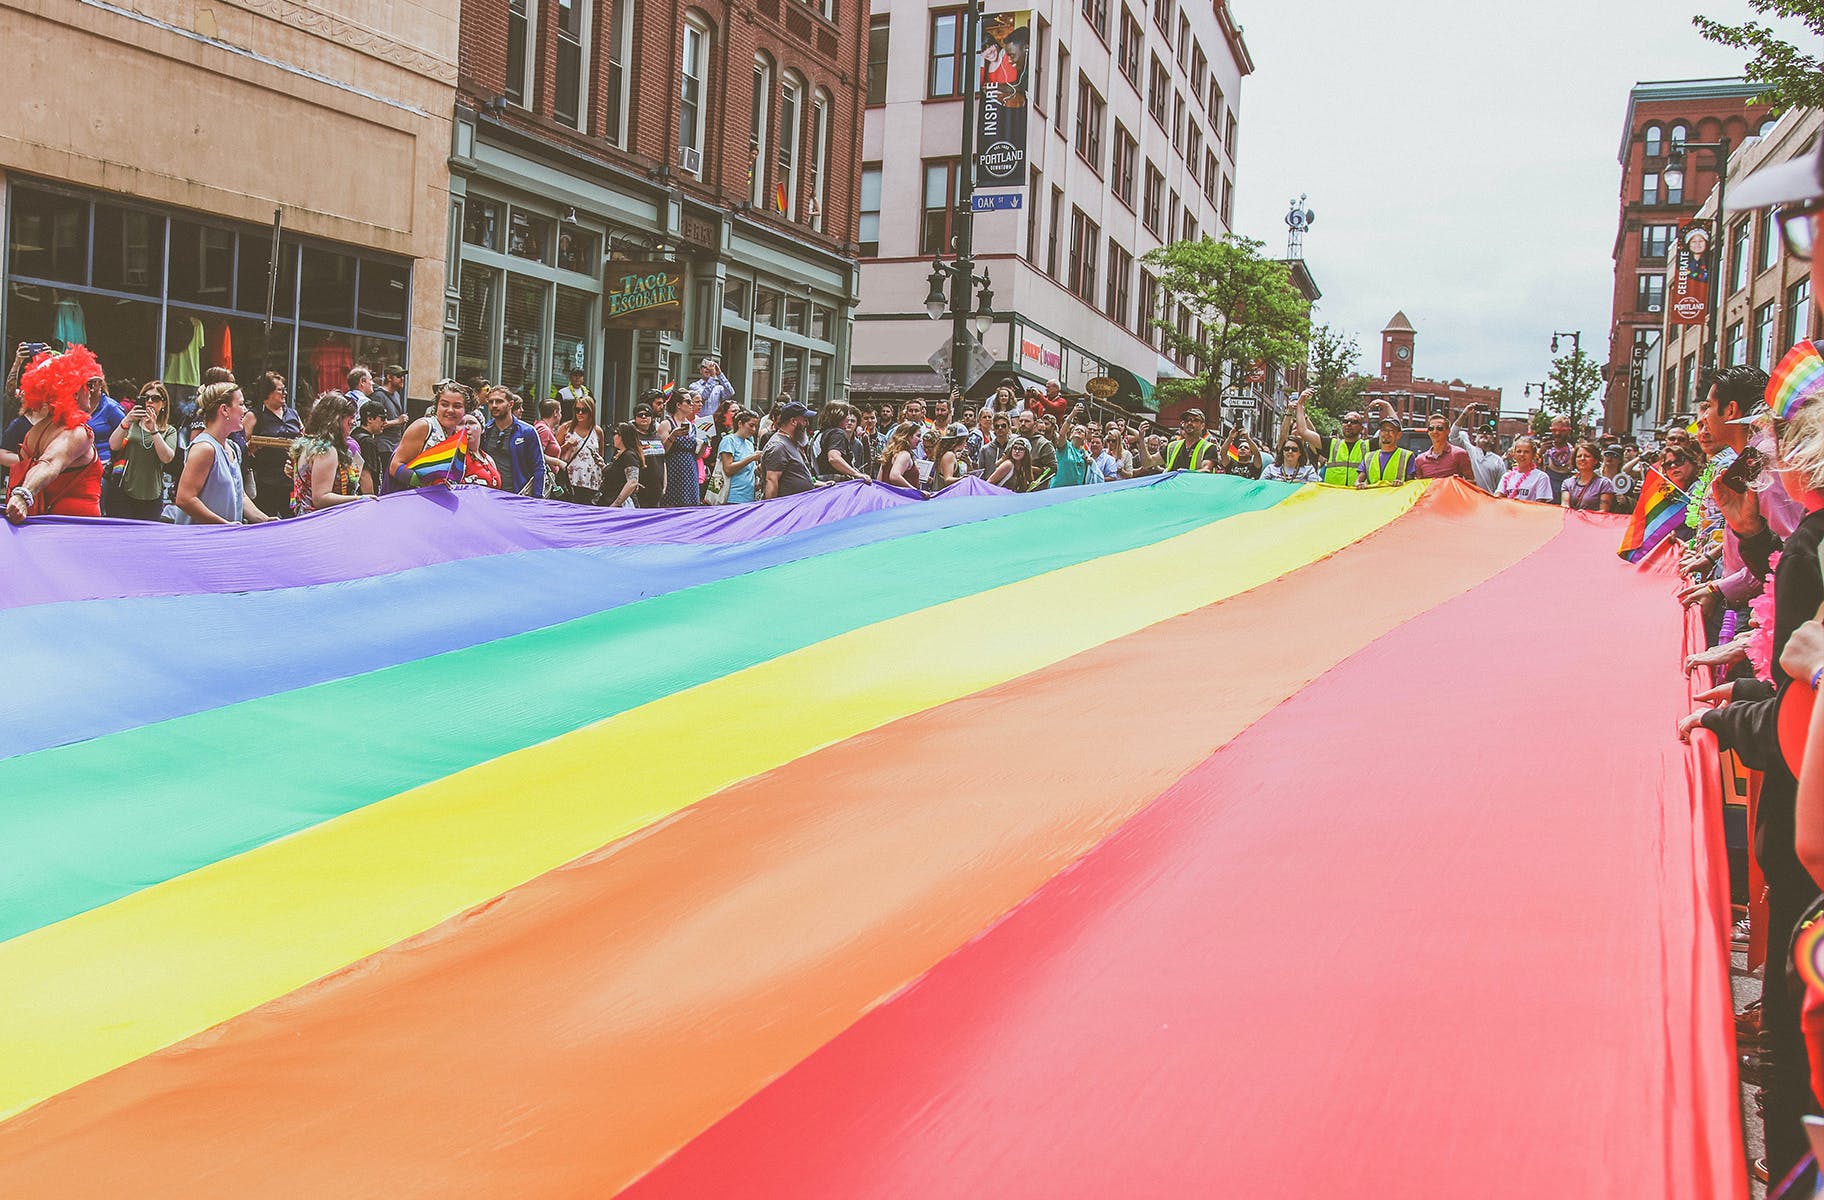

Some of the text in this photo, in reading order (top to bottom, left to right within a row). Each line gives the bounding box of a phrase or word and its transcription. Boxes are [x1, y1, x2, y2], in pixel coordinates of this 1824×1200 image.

[984, 82, 998, 136] INSPIRE
[980, 150, 1023, 165] PORTLAND
[977, 197, 995, 208] OAK
[620, 272, 667, 294] TACO
[1677, 251, 1690, 295] CELEBRATE
[608, 285, 678, 316] ESCOBARR
[1674, 302, 1705, 311] PORTLAND
[1630, 348, 1642, 409] EMPIRE
